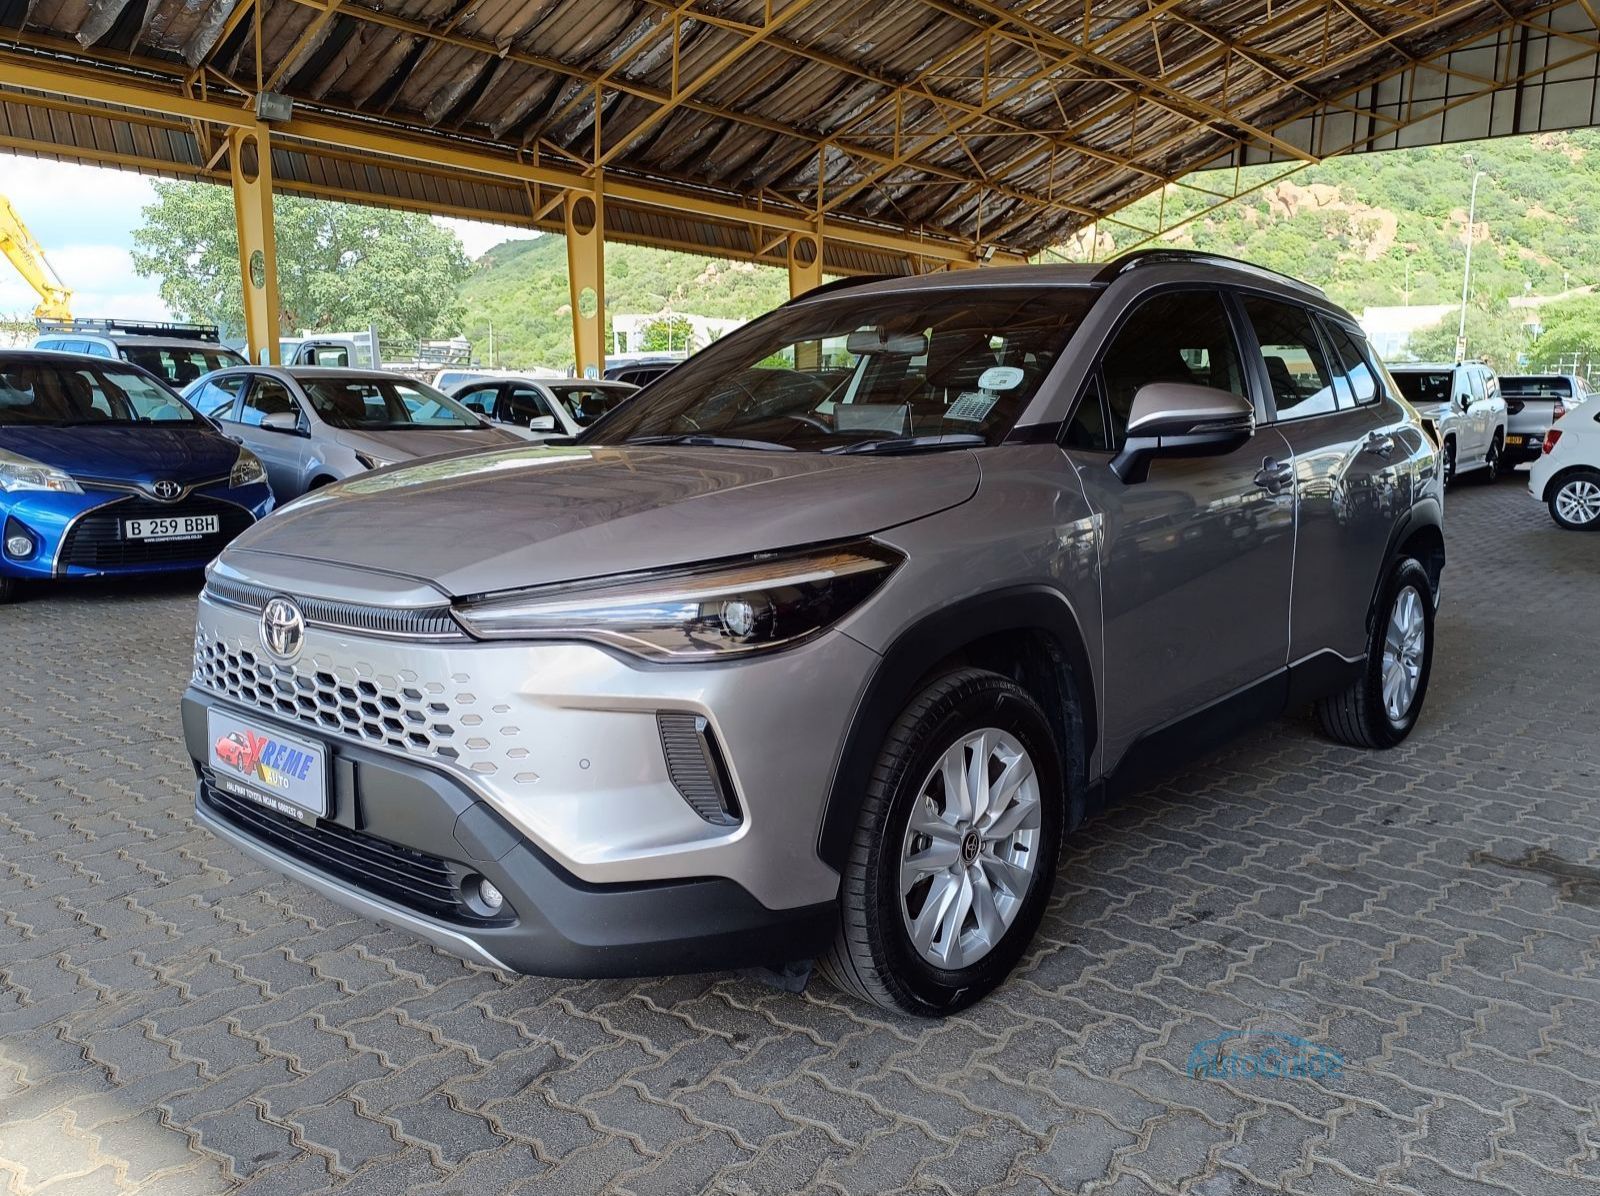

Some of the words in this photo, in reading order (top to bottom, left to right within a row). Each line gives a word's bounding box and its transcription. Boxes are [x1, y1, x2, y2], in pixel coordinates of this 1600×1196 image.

[131, 521, 142, 536] B
[149, 519, 178, 535] 259
[184, 517, 215, 533] BBH
[267, 771, 289, 789] AUTO
